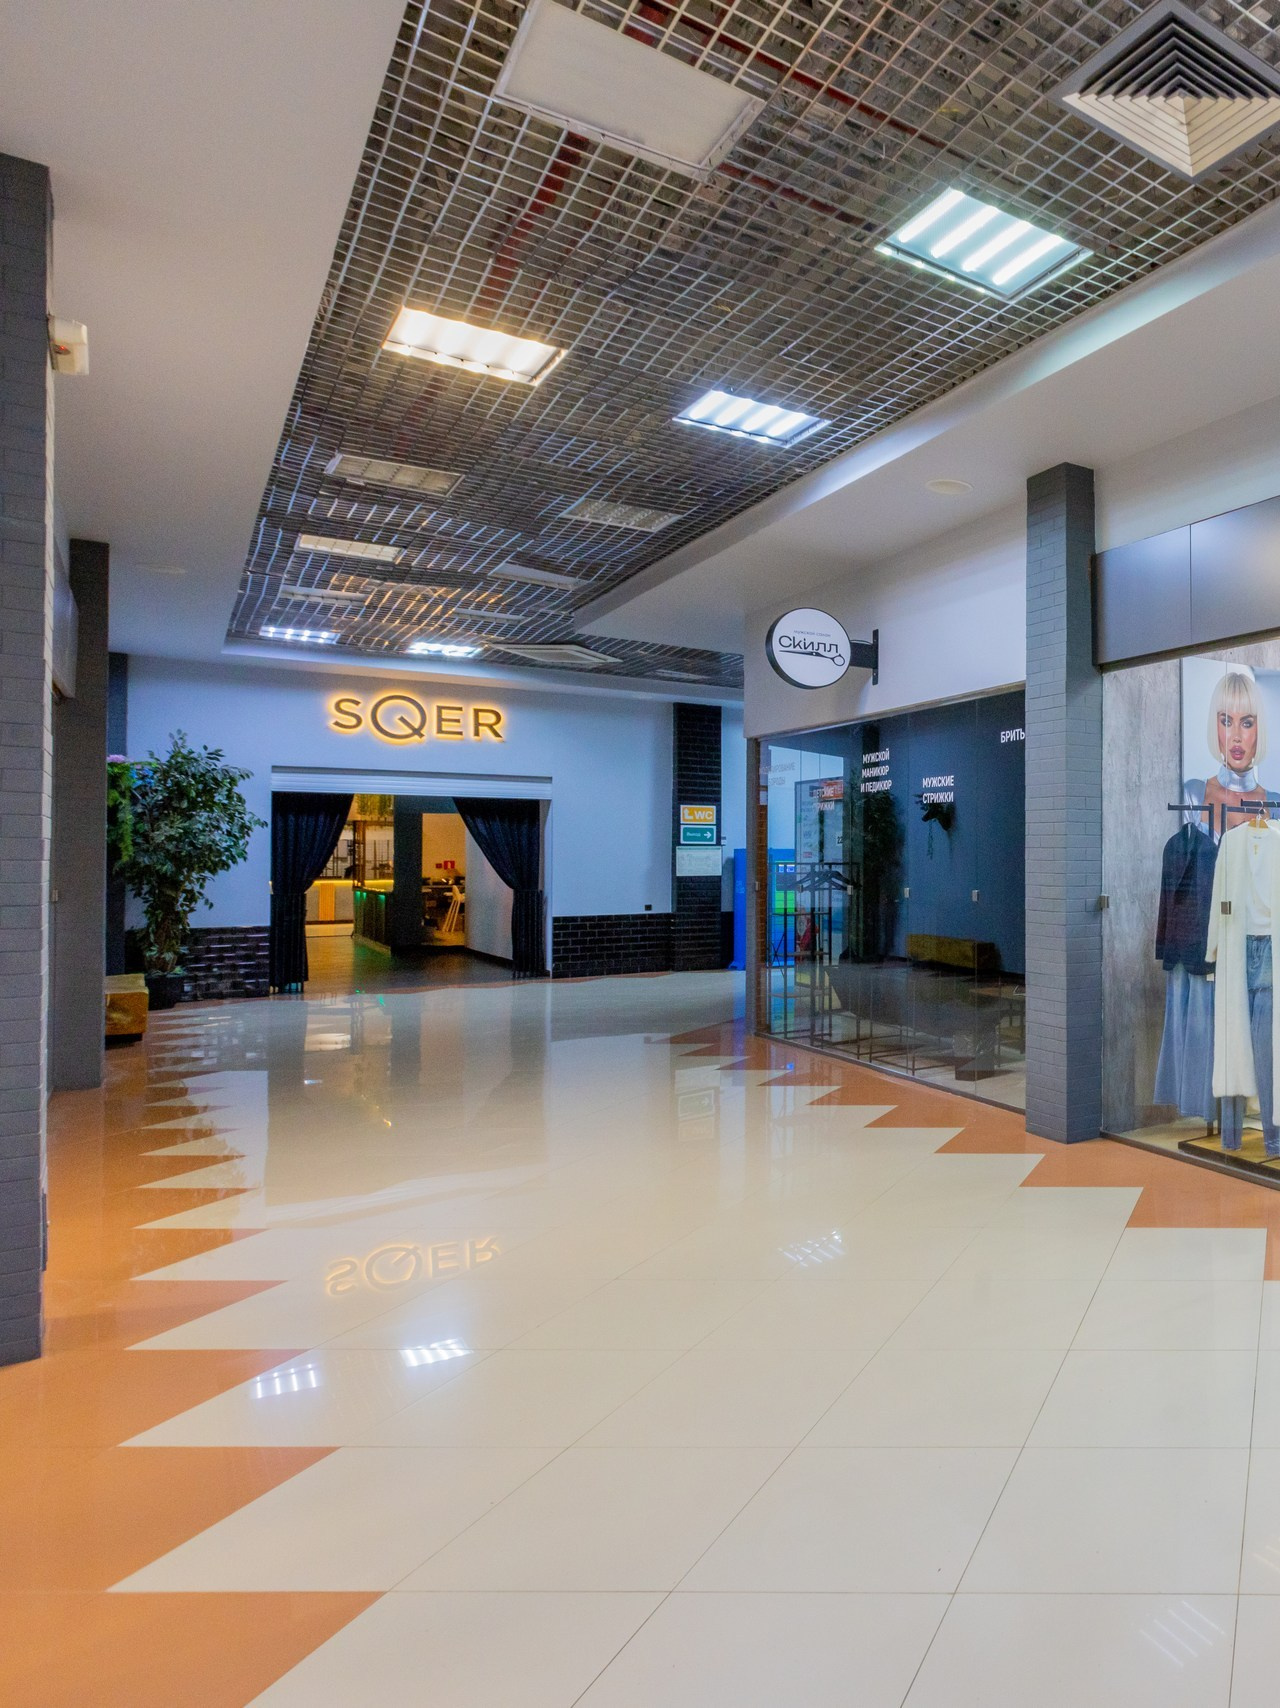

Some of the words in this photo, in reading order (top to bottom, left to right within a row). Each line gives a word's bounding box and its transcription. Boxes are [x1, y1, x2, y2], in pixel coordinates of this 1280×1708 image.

[333, 694, 503, 740] SQER
[862, 748, 889, 764] МУЖСКОЙ
[861, 765, 889, 778] МАНИКЮР
[860, 783, 865, 793] И
[865, 780, 892, 793] ПЕДИКЮР
[922, 775, 954, 788] МУЖСКИЕ
[922, 791, 954, 804] СТРИЖКИ
[694, 811, 713, 820] WC
